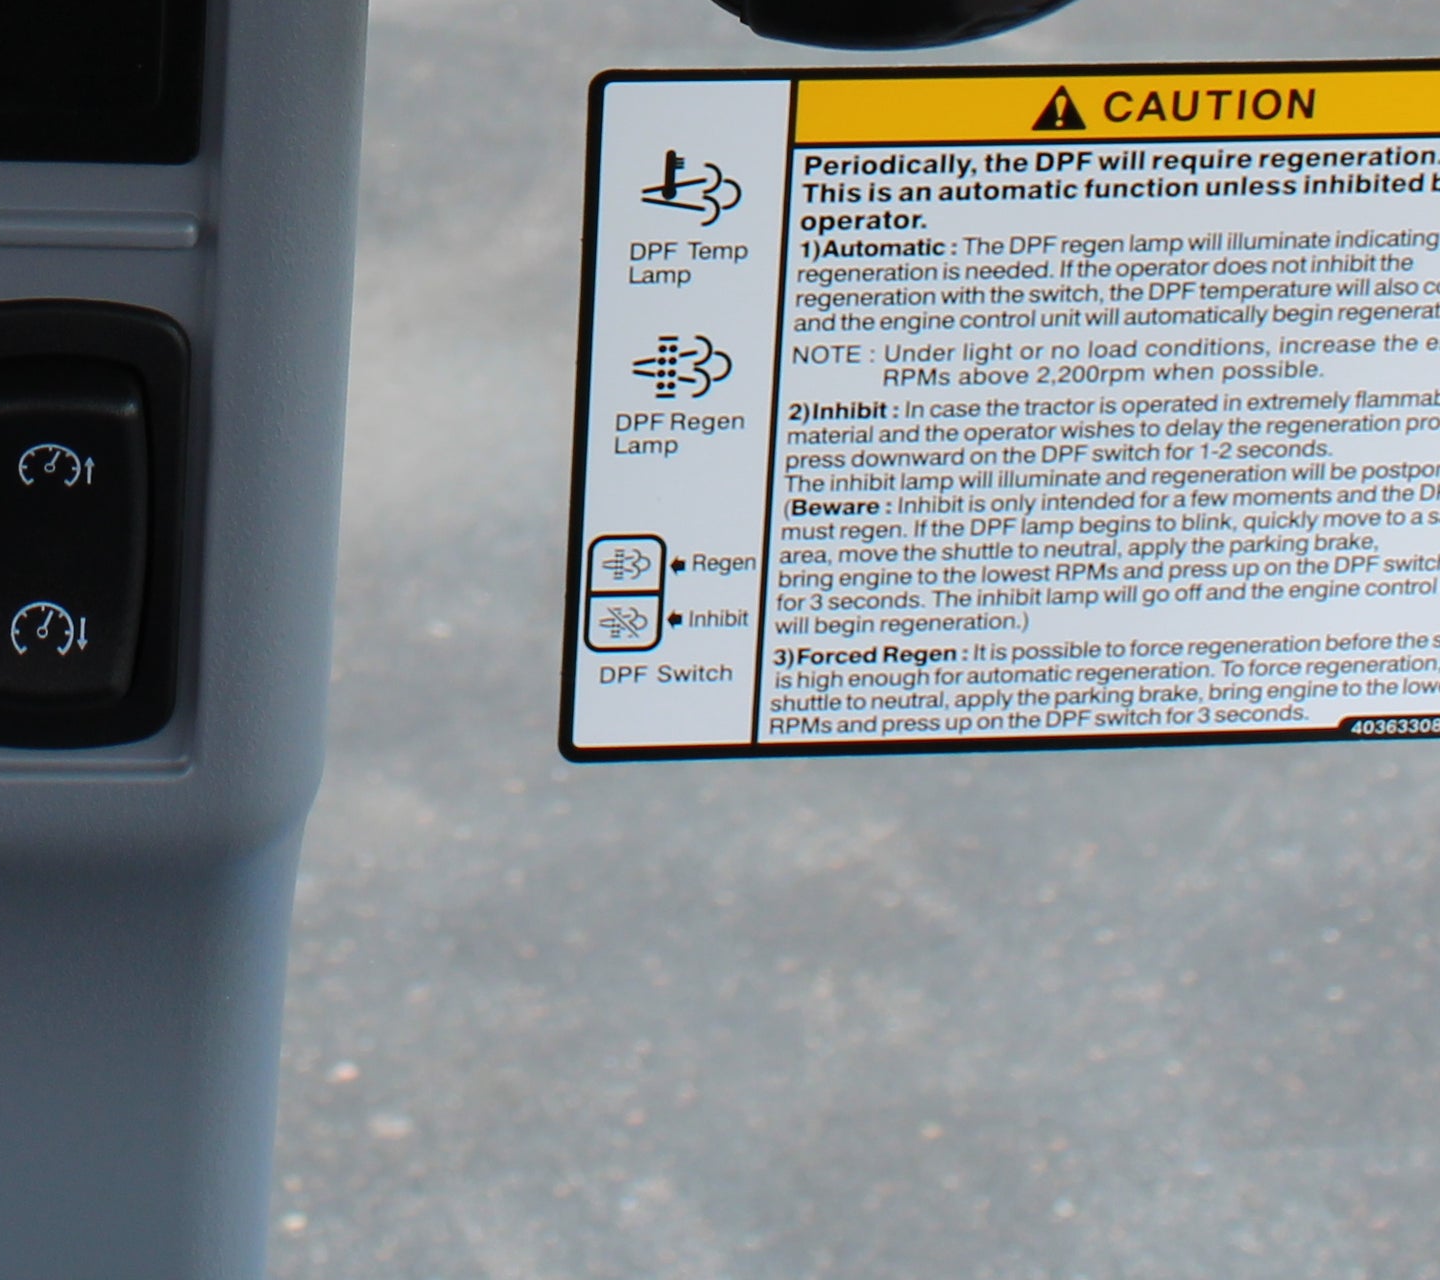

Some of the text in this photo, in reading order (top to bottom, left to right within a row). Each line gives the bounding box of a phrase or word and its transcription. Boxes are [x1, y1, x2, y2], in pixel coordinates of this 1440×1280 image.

[1103, 88, 1316, 123] CAUTION
[804, 155, 978, 180] Periodically,
[983, 155, 1029, 174] the
[1035, 153, 1094, 173] DPF
[1098, 152, 1146, 171] will
[1151, 151, 1253, 176] require
[801, 182, 862, 201] This
[868, 181, 893, 200] is
[898, 185, 932, 199] an
[937, 178, 1079, 199] automatic
[1083, 174, 1199, 196] function
[1205, 175, 1298, 194] unless
[1303, 172, 1426, 192] inhibited
[799, 211, 927, 237] operator.
[629, 241, 749, 265] DPF Temp
[800, 237, 946, 262] 1)Automatic
[962, 236, 1005, 254] The
[1009, 235, 1057, 254] DPF
[1060, 238, 1125, 257] regen
[1129, 234, 1184, 256] lamp
[1187, 232, 1223, 250] will
[1227, 231, 1332, 250] illuminate
[1335, 228, 1440, 251] indicating
[628, 265, 692, 289] Lamp
[796, 253, 1414, 288] regeneration is needed. If the operator does not inhibit the
[795, 287, 936, 313] regeneration
[940, 286, 986, 305] with
[989, 285, 1025, 304] the
[1028, 283, 1104, 304] switch,
[1109, 283, 1144, 302] the
[1148, 281, 1197, 301] DPF
[1199, 281, 1332, 304] temperature
[1336, 278, 1371, 297] will
[1373, 277, 1420, 297] also
[793, 313, 836, 332] and
[840, 312, 876, 331] the
[879, 311, 956, 335] engine
[959, 309, 1037, 329] control
[1040, 308, 1082, 327] unit
[1084, 307, 1120, 326] will
[1123, 305, 1268, 328] automatically
[1272, 303, 1333, 327] begin
[792, 344, 861, 363] NOTE
[884, 343, 956, 361] Under
[962, 342, 1013, 364] light
[1019, 345, 1044, 358] or
[1051, 344, 1080, 358] no
[1088, 339, 1138, 357] load
[1145, 338, 1270, 358] conditions,
[1279, 336, 1377, 353] increase
[1383, 334, 1419, 351] the
[882, 360, 1324, 386] RPMs above 2,200rpm when possible.
[615, 412, 745, 436] DPF Regen
[787, 425, 874, 445] material
[878, 424, 921, 444] and
[924, 424, 960, 443] the
[963, 423, 1057, 446] operator
[1060, 420, 1135, 439] wishes
[1139, 420, 1161, 438] to
[1165, 418, 1224, 441] delay
[1228, 417, 1262, 435] the
[1266, 415, 1401, 439] regeneration
[614, 436, 679, 459] Lamp
[785, 439, 1332, 474] press downward on the DPF switch for 1-2 seconds.
[783, 474, 825, 492] The
[830, 473, 896, 491] inhibit
[900, 473, 954, 494] lamp
[959, 470, 993, 488] will
[998, 469, 1101, 488] illuminate
[1105, 467, 1147, 485] and
[1151, 464, 1287, 489] regeneration
[1292, 463, 1326, 481] will
[1330, 462, 1357, 480] be
[779, 533, 1379, 566] area, move the shuttle to neutral, apply the parking brake,
[692, 553, 757, 576] Regen
[688, 609, 749, 628] Inhibit
[774, 612, 1029, 639] will begin regeneration.)
[599, 664, 733, 685] DPF Switch
[775, 672, 793, 690] is
[796, 670, 844, 693] high
[847, 668, 930, 691] enough
[934, 668, 963, 686] for
[966, 665, 1072, 685] automatic
[1076, 662, 1215, 686] regeneration.
[1221, 661, 1245, 678] To
[1248, 660, 1302, 677] force
[769, 705, 1308, 737] RPMs and press up on the DPF switch for 3 seconds.
